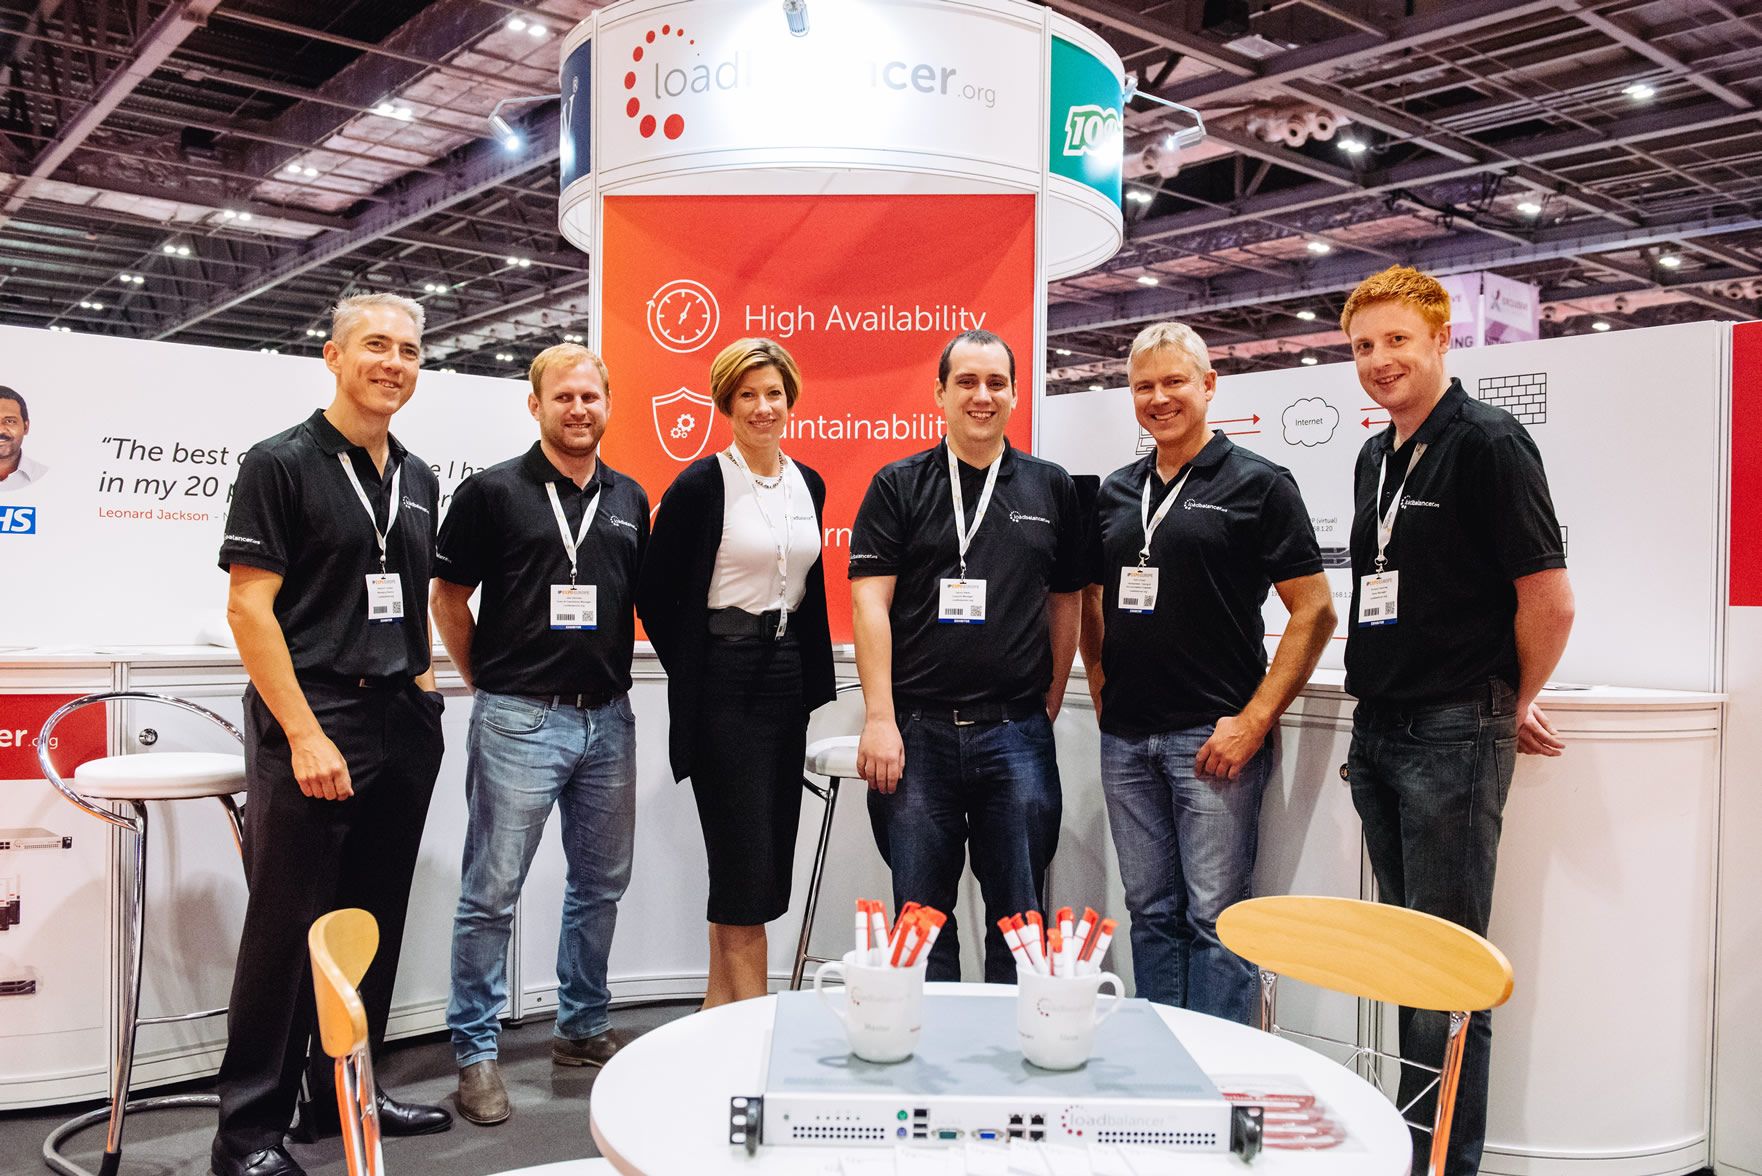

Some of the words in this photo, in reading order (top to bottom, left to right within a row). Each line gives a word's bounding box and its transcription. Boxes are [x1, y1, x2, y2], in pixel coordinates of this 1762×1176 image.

[745, 304, 815, 338] High
[825, 304, 987, 331] Availability
[780, 413, 948, 440] intainabilit
[1295, 417, 1323, 426] Internet
[172, 442, 229, 465] best
[99, 471, 124, 492] in
[134, 477, 177, 500] my
[184, 475, 219, 497] 20
[99, 507, 153, 519] Leonard
[157, 509, 209, 521] Jackson
